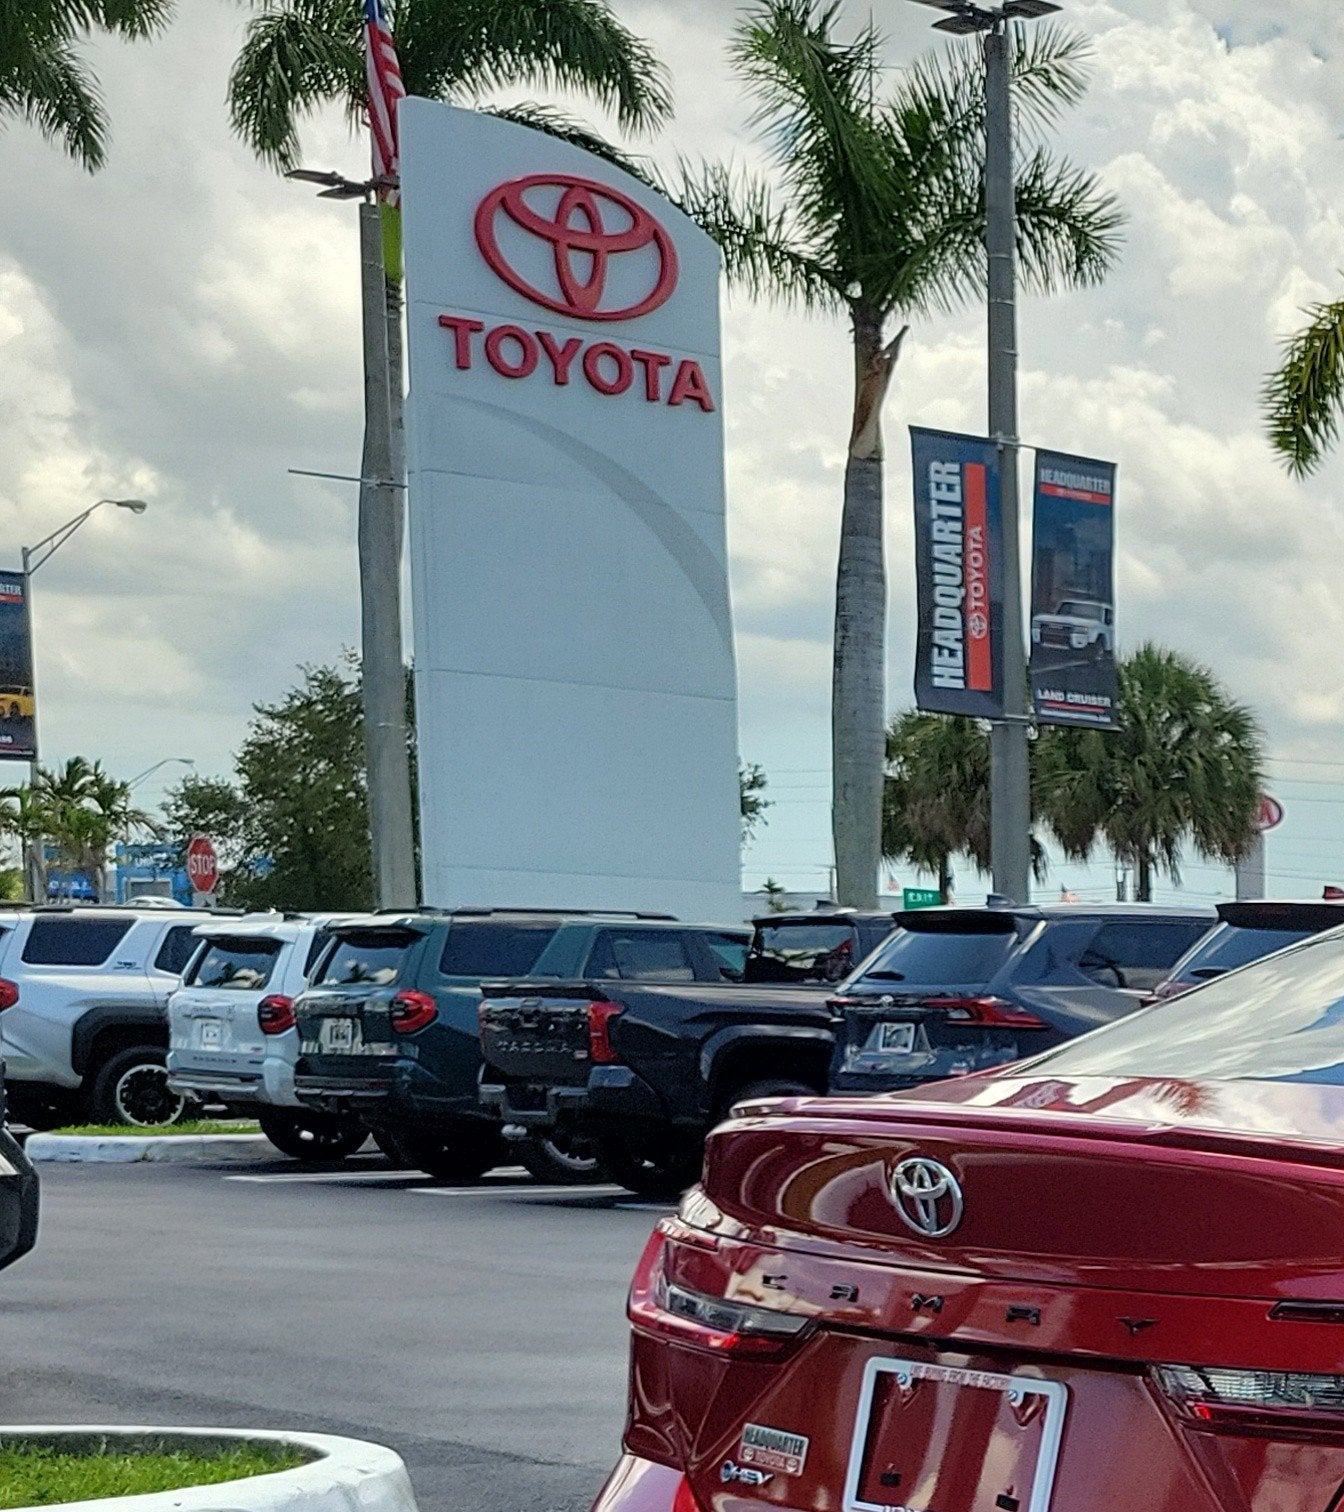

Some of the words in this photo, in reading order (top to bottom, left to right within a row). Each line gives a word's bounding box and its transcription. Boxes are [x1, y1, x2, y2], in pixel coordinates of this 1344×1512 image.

[438, 314, 715, 412] TOYOTA
[930, 461, 966, 689] HEADQUARTER
[967, 526, 985, 608] TOYOTA
[190, 854, 215, 875] STOP
[762, 1273, 1160, 1336] CAMRY
[742, 1426, 806, 1458] HEADQUARTER
